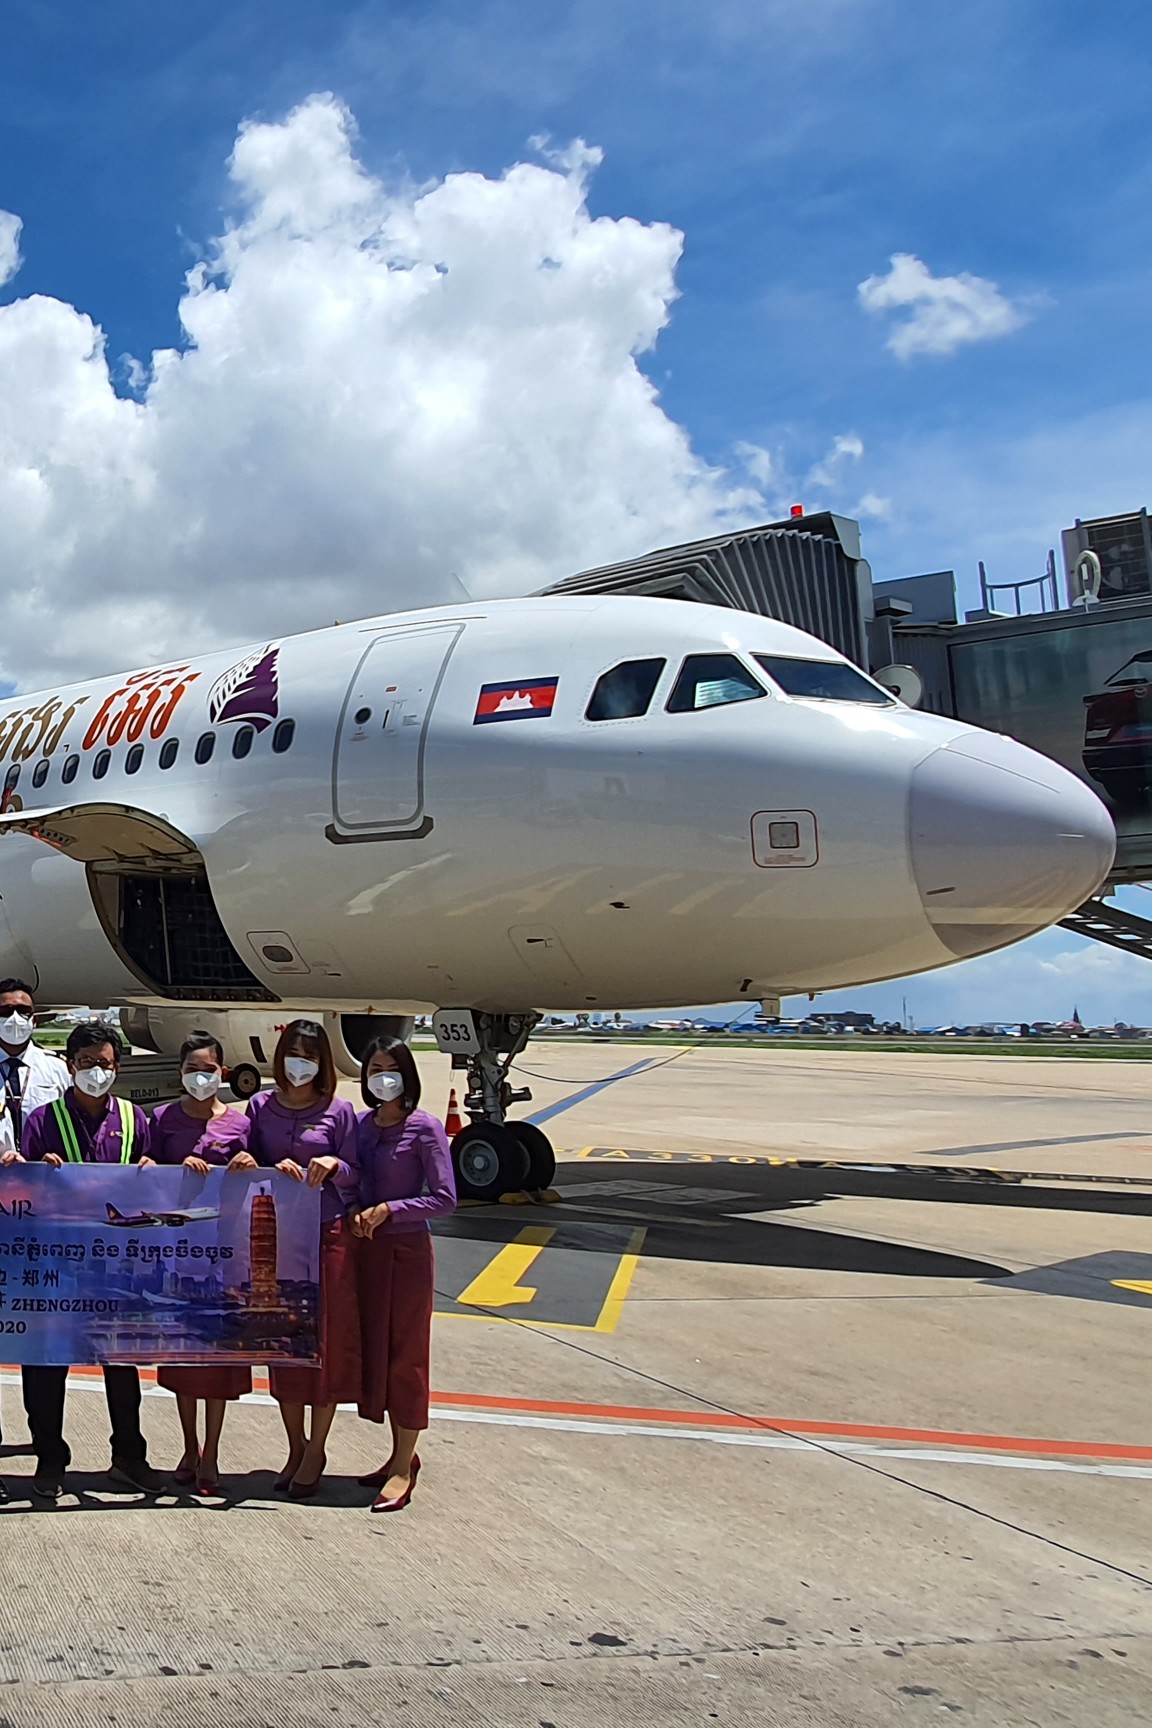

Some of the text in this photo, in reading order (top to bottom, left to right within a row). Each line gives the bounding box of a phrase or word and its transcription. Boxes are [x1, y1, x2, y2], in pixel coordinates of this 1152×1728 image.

[439, 1023, 471, 1042] 353
[91, 1238, 121, 1259] និង
[10, 1297, 120, 1314] ZHENGZHOU
